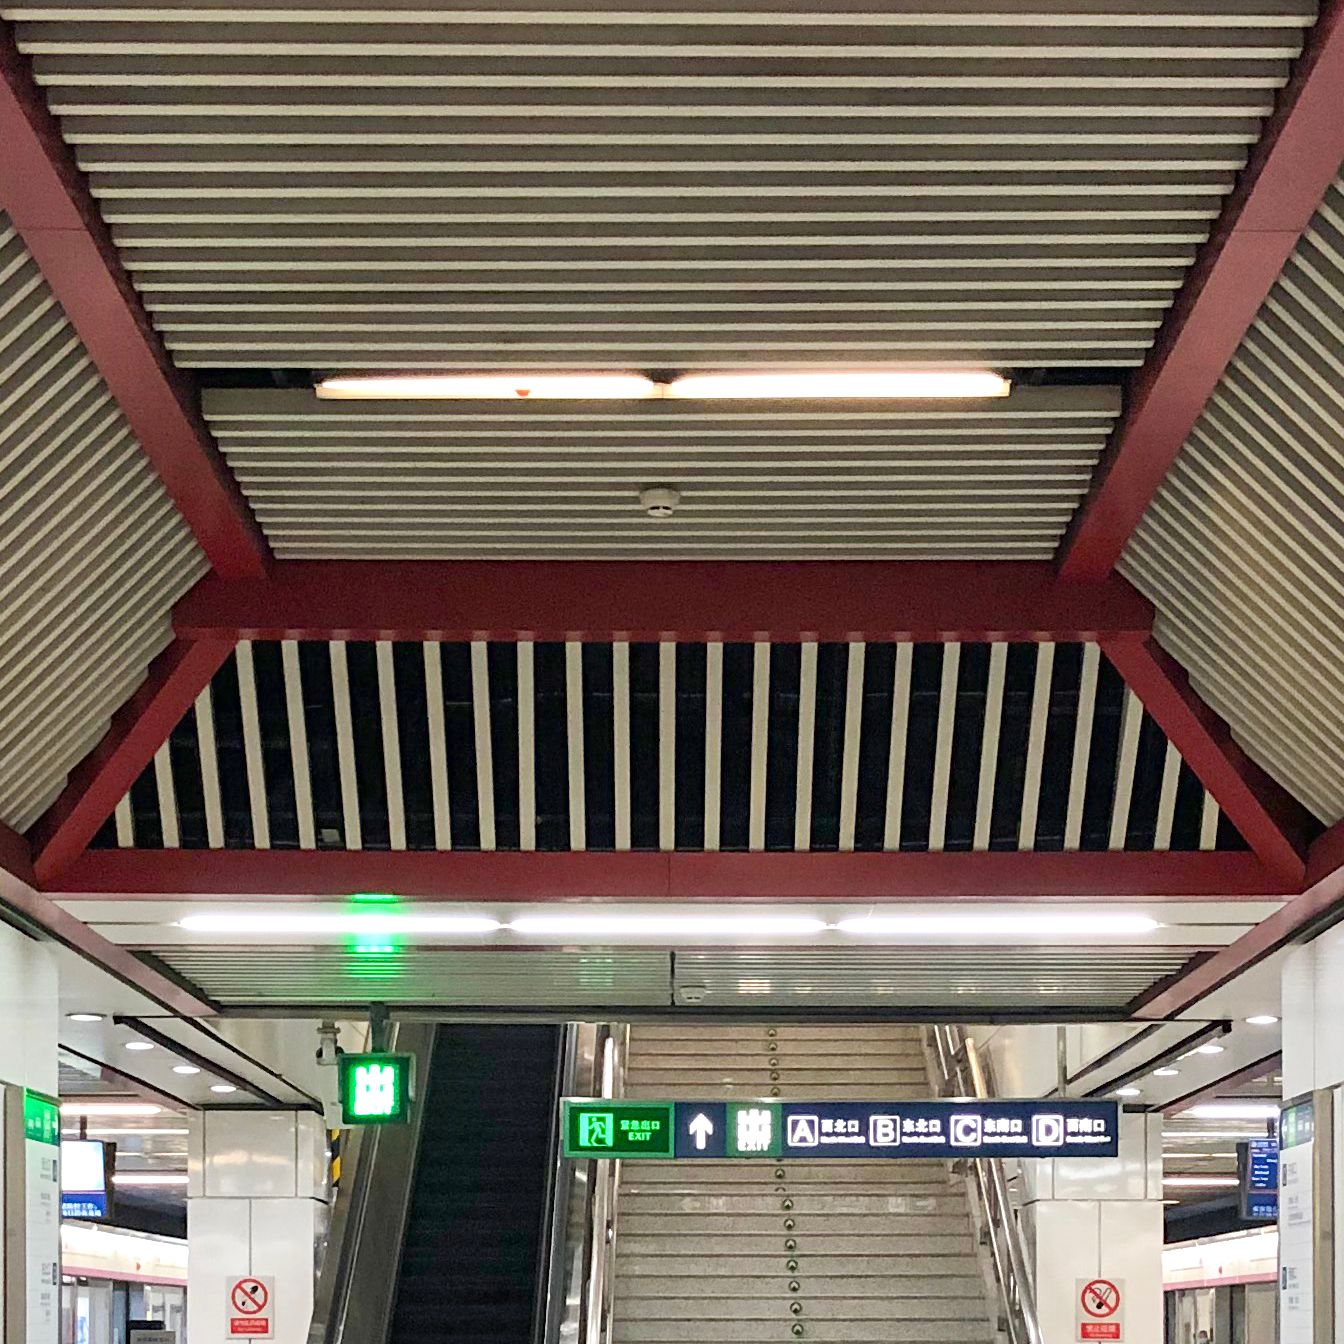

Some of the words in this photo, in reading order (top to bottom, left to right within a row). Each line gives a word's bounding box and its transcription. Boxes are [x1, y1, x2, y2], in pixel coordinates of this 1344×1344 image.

[628, 1132, 652, 1142] EXIT
[792, 1119, 814, 1143] A
[876, 1119, 895, 1143] B
[956, 1118, 977, 1143] C
[1038, 1118, 1059, 1143] D
